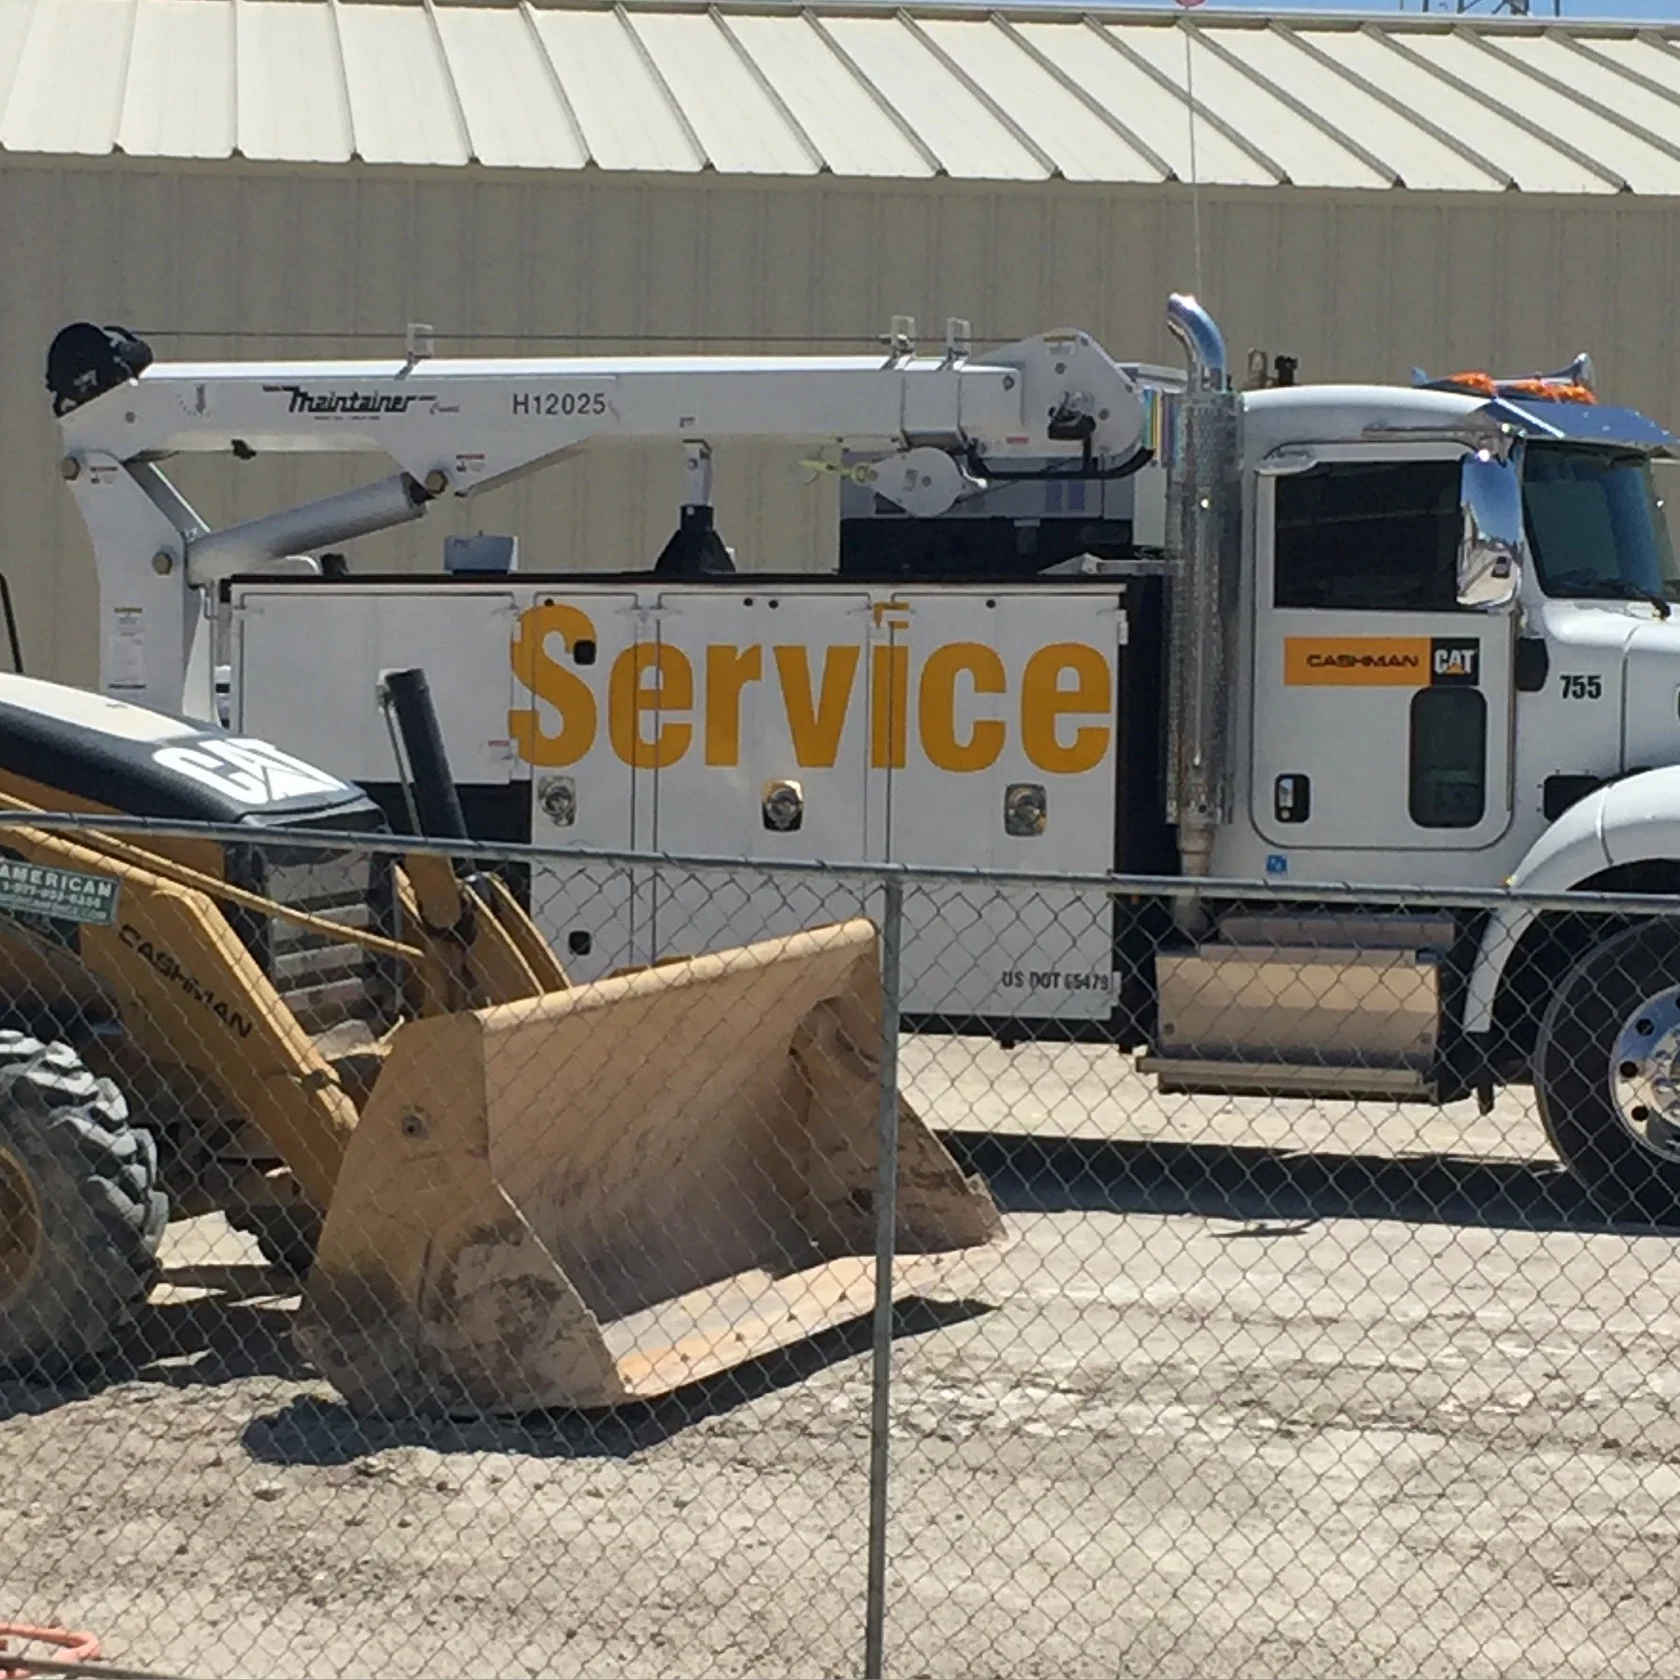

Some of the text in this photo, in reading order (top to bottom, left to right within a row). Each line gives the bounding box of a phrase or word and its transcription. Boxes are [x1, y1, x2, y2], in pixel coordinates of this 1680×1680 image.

[268, 386, 430, 413] Maintainer
[512, 392, 606, 415] H12025
[1306, 654, 1420, 668] CASHMAN
[1434, 650, 1476, 675] CAT
[508, 603, 1111, 774] Service
[1559, 674, 1602, 700] 755
[152, 737, 349, 805] CAT
[0, 863, 112, 898] AMERICAN
[118, 924, 253, 1038] CASHMAN
[1001, 970, 1025, 988] US
[1029, 971, 1061, 989] DOT
